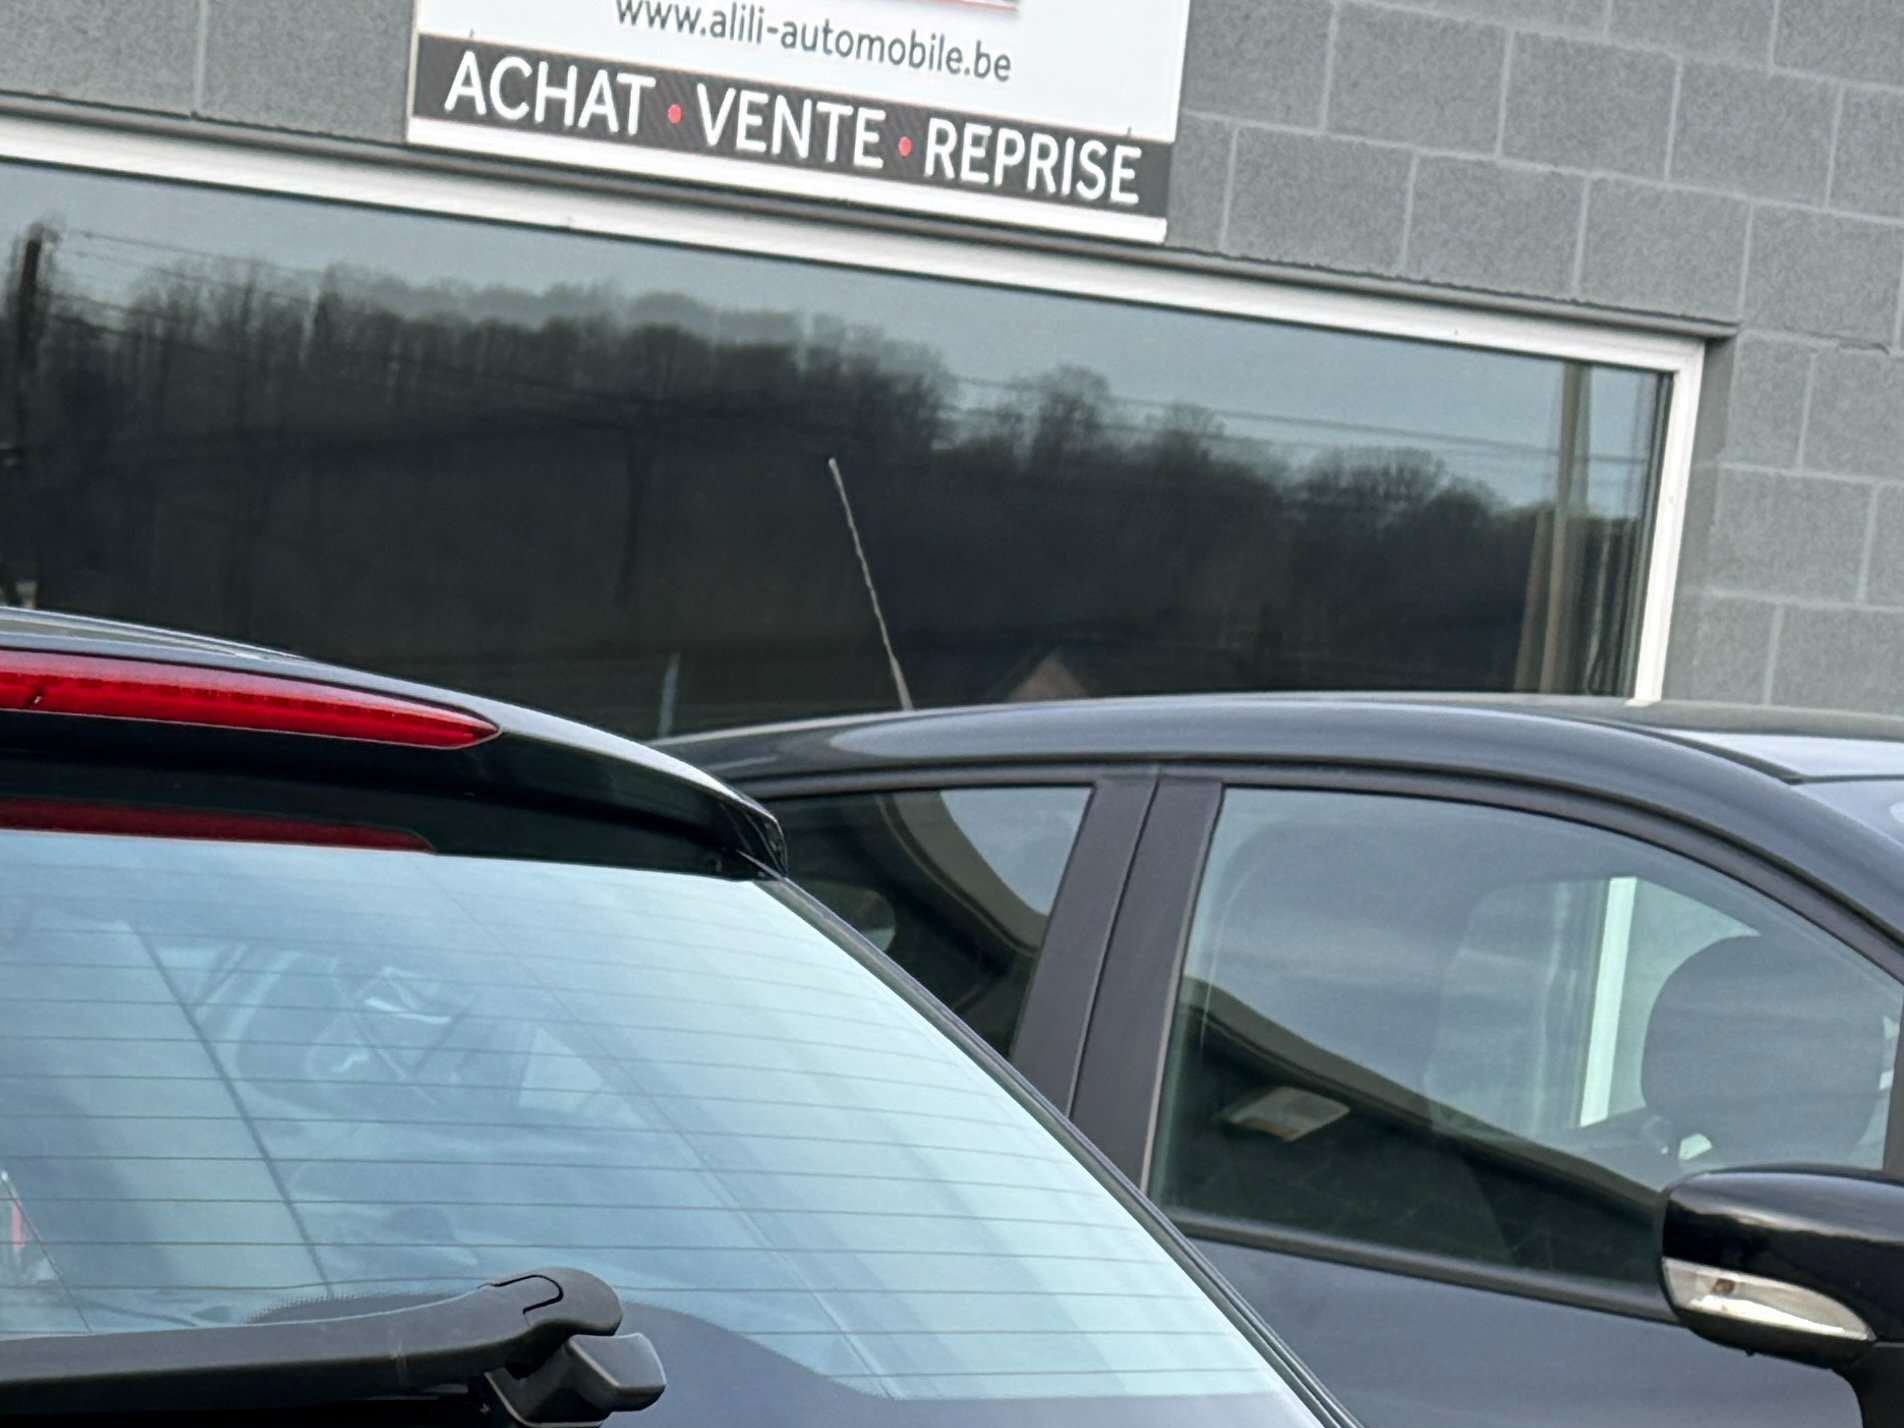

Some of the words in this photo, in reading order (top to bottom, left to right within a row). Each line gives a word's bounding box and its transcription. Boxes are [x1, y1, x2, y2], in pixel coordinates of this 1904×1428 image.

[616, 0, 1012, 83] www.alili-automobile.be
[444, 50, 656, 136] ACHAT
[696, 81, 887, 169] VENTE
[924, 117, 1143, 205] REPRISE
